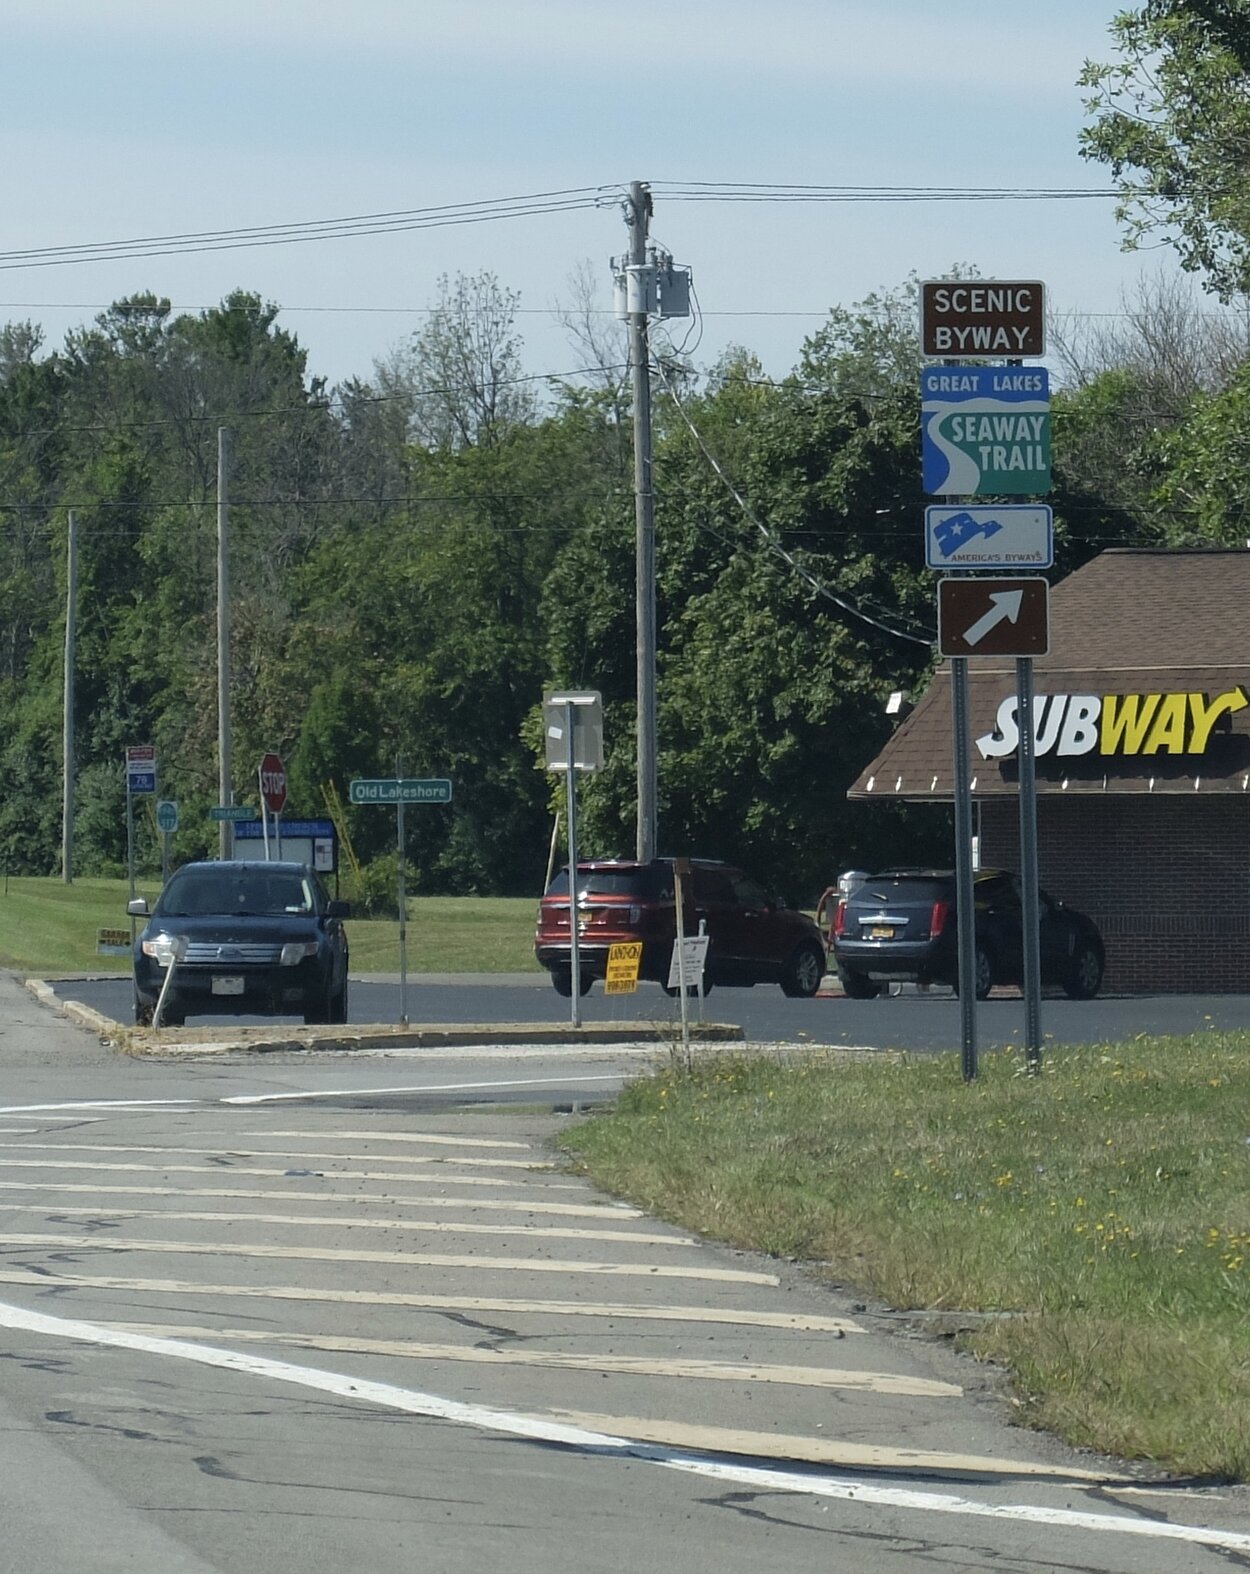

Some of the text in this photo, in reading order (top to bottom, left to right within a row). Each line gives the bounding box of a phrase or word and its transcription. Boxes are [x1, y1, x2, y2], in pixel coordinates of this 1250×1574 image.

[935, 288, 1031, 313] SCENIC
[935, 326, 1030, 350] BYWAY
[927, 375, 1043, 392] GREAT LAKES
[951, 416, 1044, 442] SEAWAY
[978, 445, 1046, 471] TRAIL
[952, 553, 1001, 561] AMERICA'S
[975, 685, 1249, 760] SUBWAY
[262, 772, 285, 794] STOP
[356, 785, 446, 799] Old Lakeshore
